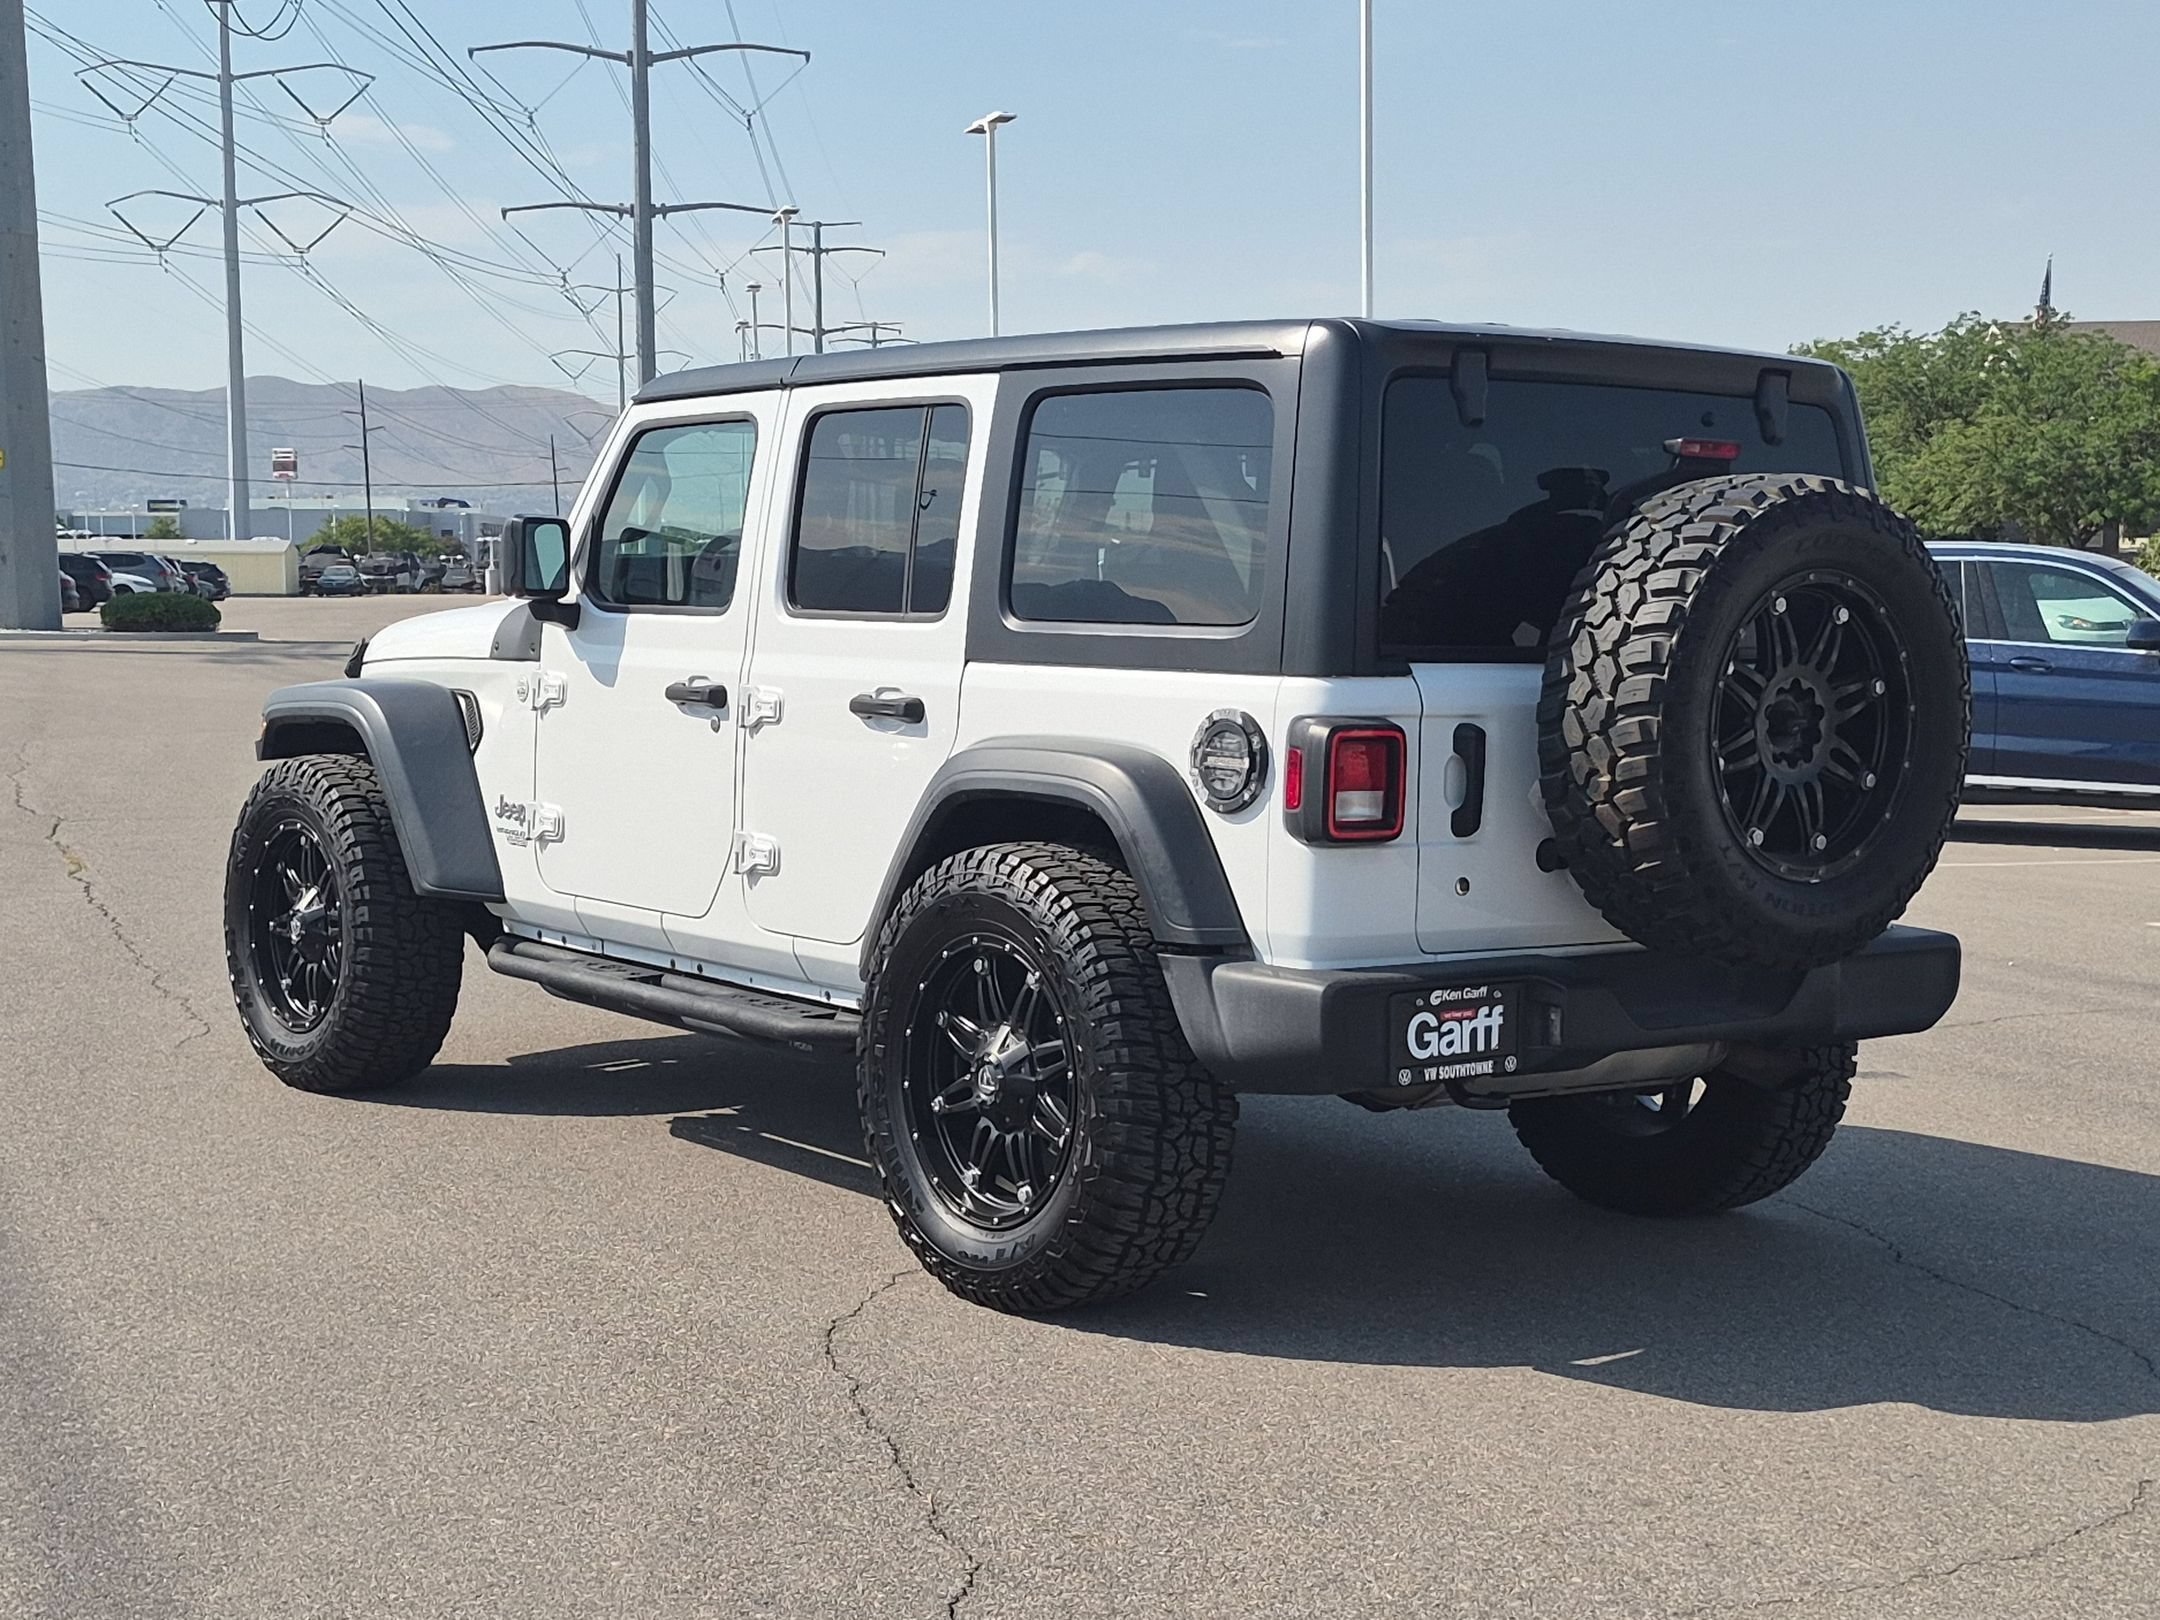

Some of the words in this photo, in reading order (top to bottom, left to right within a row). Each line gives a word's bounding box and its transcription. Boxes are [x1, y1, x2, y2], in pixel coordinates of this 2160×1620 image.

[495, 794, 526, 827] Jeep
[1442, 989, 1461, 1001] Ken
[1463, 986, 1488, 999] Garff
[1407, 1005, 1504, 1060] Garff
[1424, 1067, 1438, 1081] VW
[1439, 1060, 1494, 1080] SOUTHTOWNE
